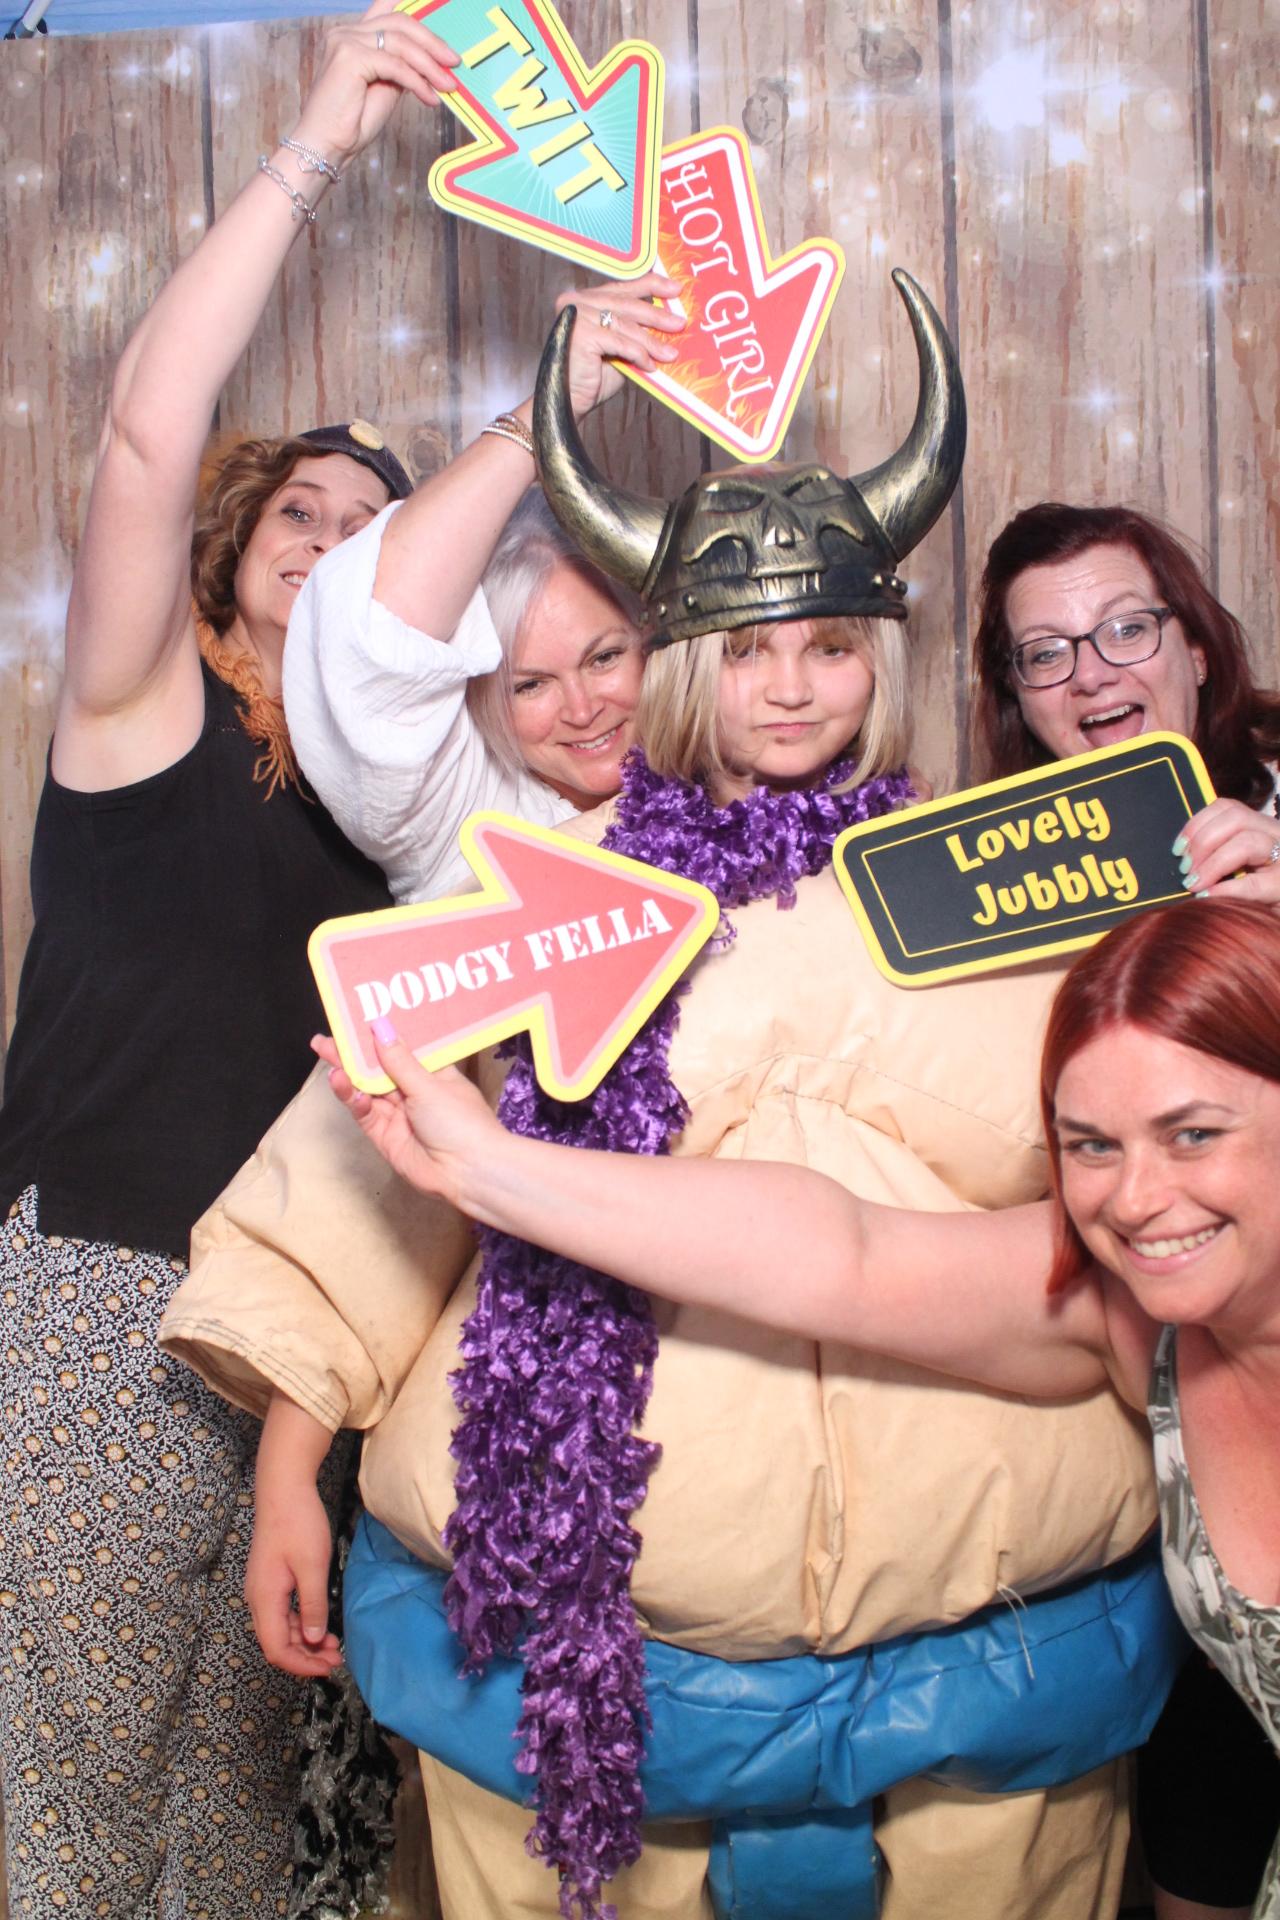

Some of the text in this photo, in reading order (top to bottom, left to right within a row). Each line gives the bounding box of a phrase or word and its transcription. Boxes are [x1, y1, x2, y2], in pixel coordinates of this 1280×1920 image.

[461, 5, 628, 205] TWIT
[665, 162, 774, 421] HOT GIRL
[946, 795, 1111, 872] Lovely
[972, 854, 1139, 926] Jubbly
[354, 898, 673, 1022] DODGY FELLA
